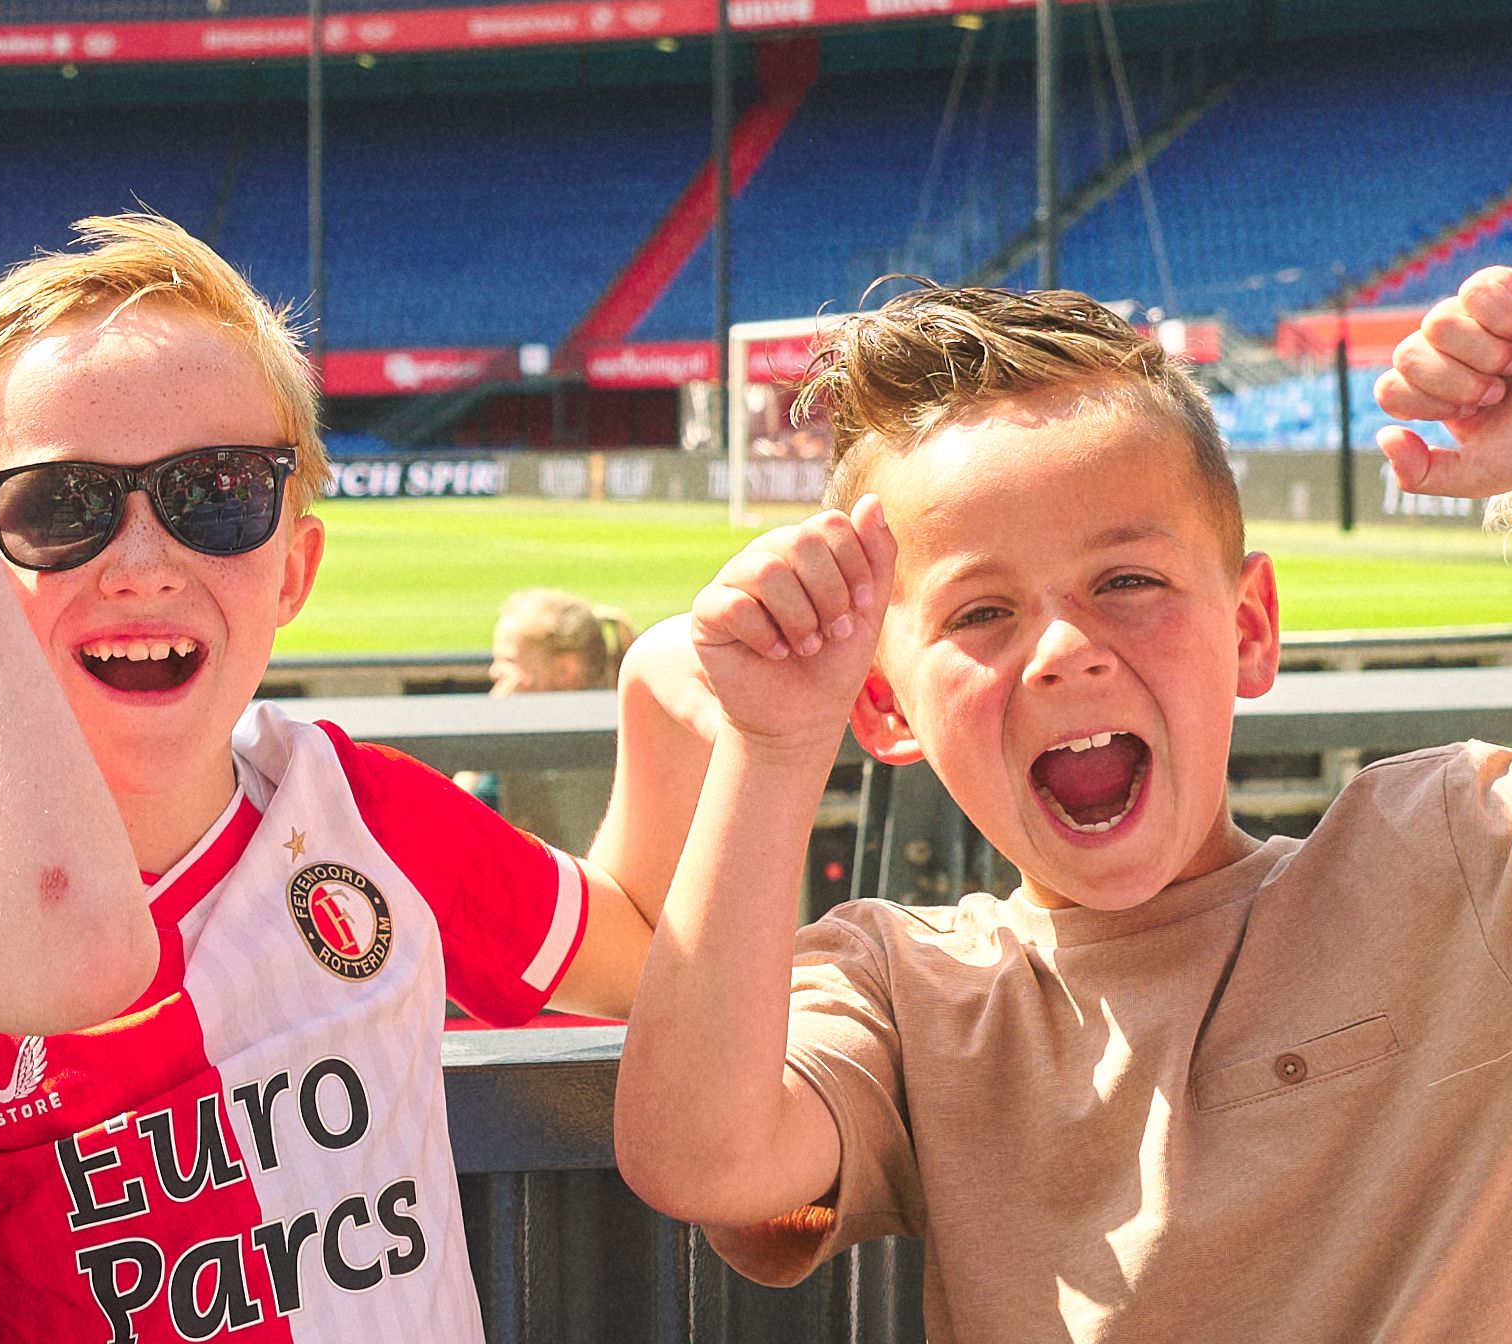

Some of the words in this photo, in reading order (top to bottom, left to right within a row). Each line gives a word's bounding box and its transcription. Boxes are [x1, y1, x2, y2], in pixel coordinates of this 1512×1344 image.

[293, 865, 367, 919] FEYENOORD
[318, 916, 392, 976] ROTTERDAM
[54, 1055, 372, 1233] Euro
